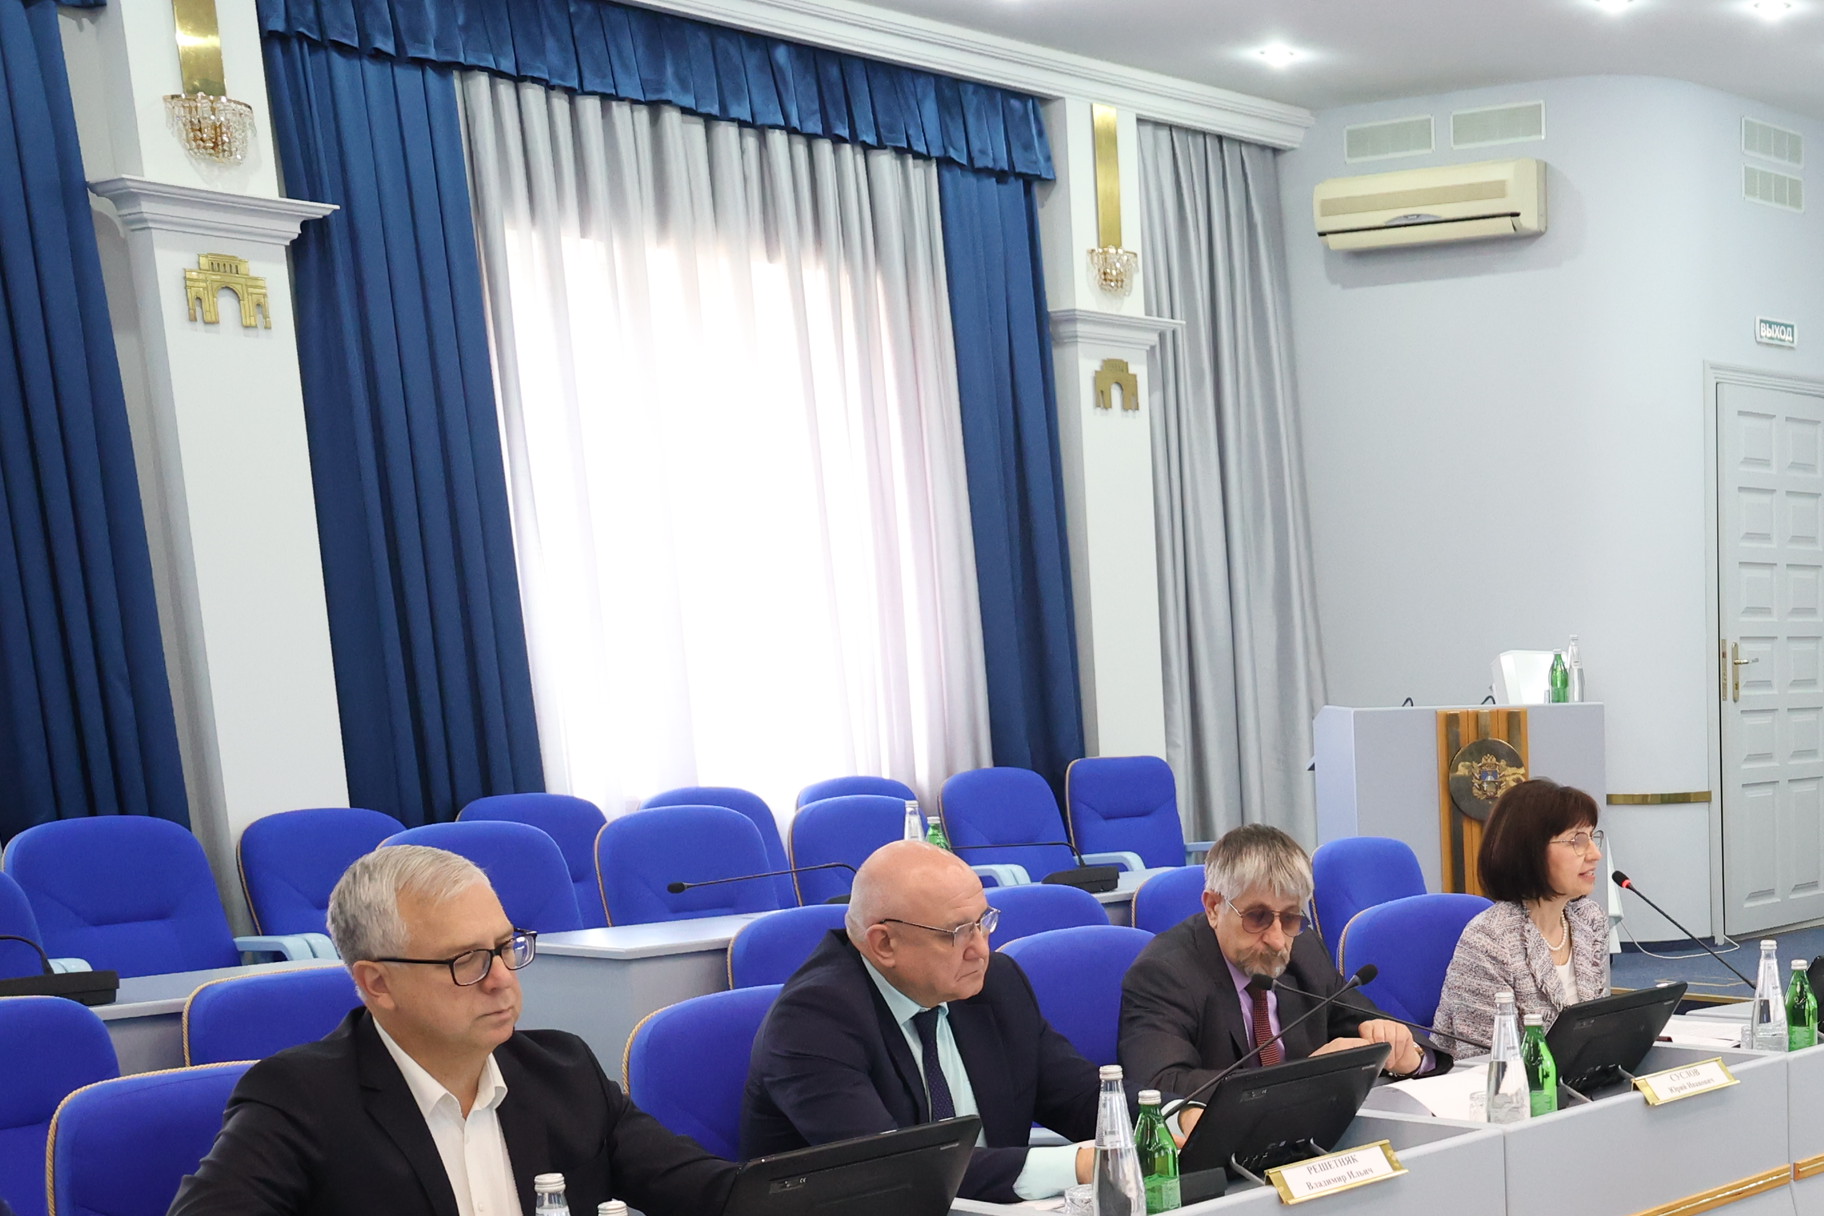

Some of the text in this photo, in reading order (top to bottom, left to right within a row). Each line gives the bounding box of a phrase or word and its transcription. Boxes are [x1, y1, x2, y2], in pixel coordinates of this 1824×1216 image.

[1760, 322, 1793, 342] ВЫХОД
[1669, 1068, 1701, 1082] СУСЛОВ
[1668, 1078, 1715, 1094] Юрий Иванович
[1306, 1154, 1359, 1176] РЕШЕТНЯК
[1305, 1167, 1374, 1191] Владимир Ильич
